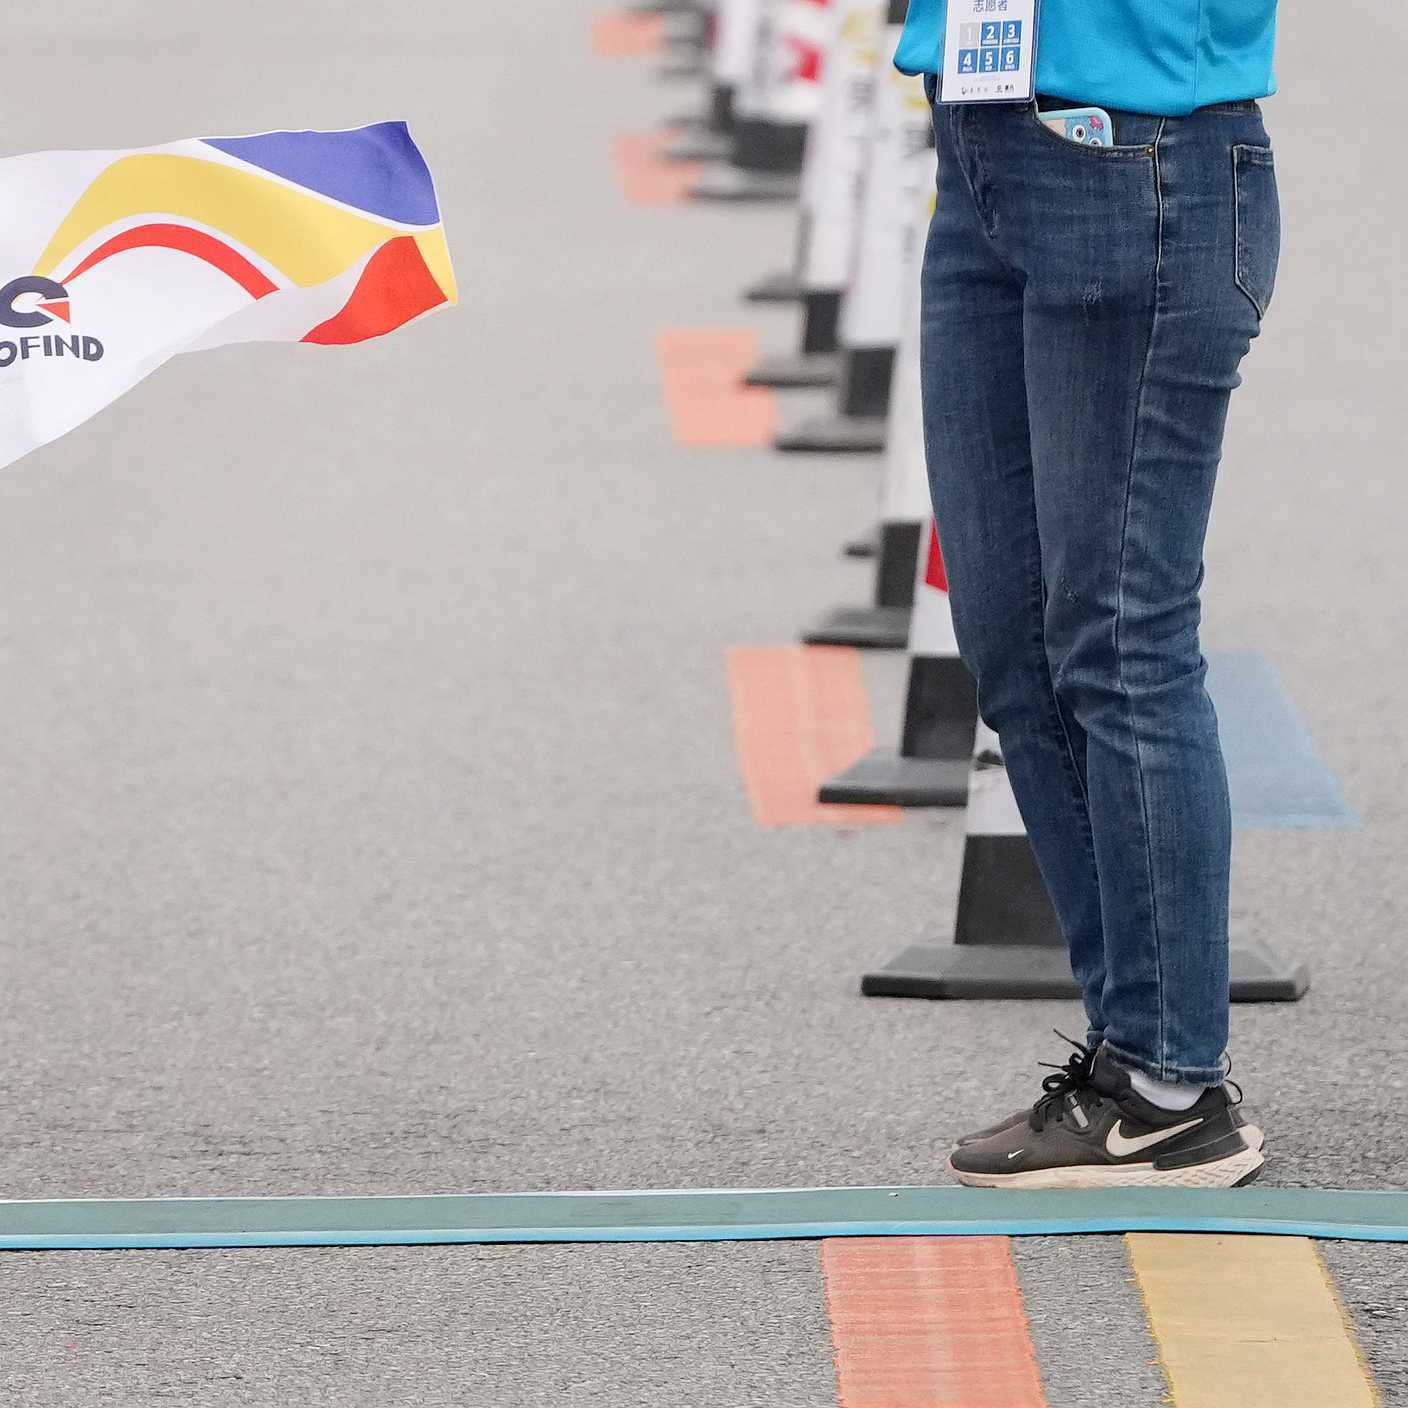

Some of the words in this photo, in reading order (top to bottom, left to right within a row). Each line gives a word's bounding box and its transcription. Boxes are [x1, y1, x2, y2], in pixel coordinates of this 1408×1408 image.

[986, 25, 995, 40] 2
[1007, 23, 1016, 38] 3
[963, 52, 972, 67] 4
[985, 51, 993, 65] 5
[1006, 50, 1014, 64] 6
